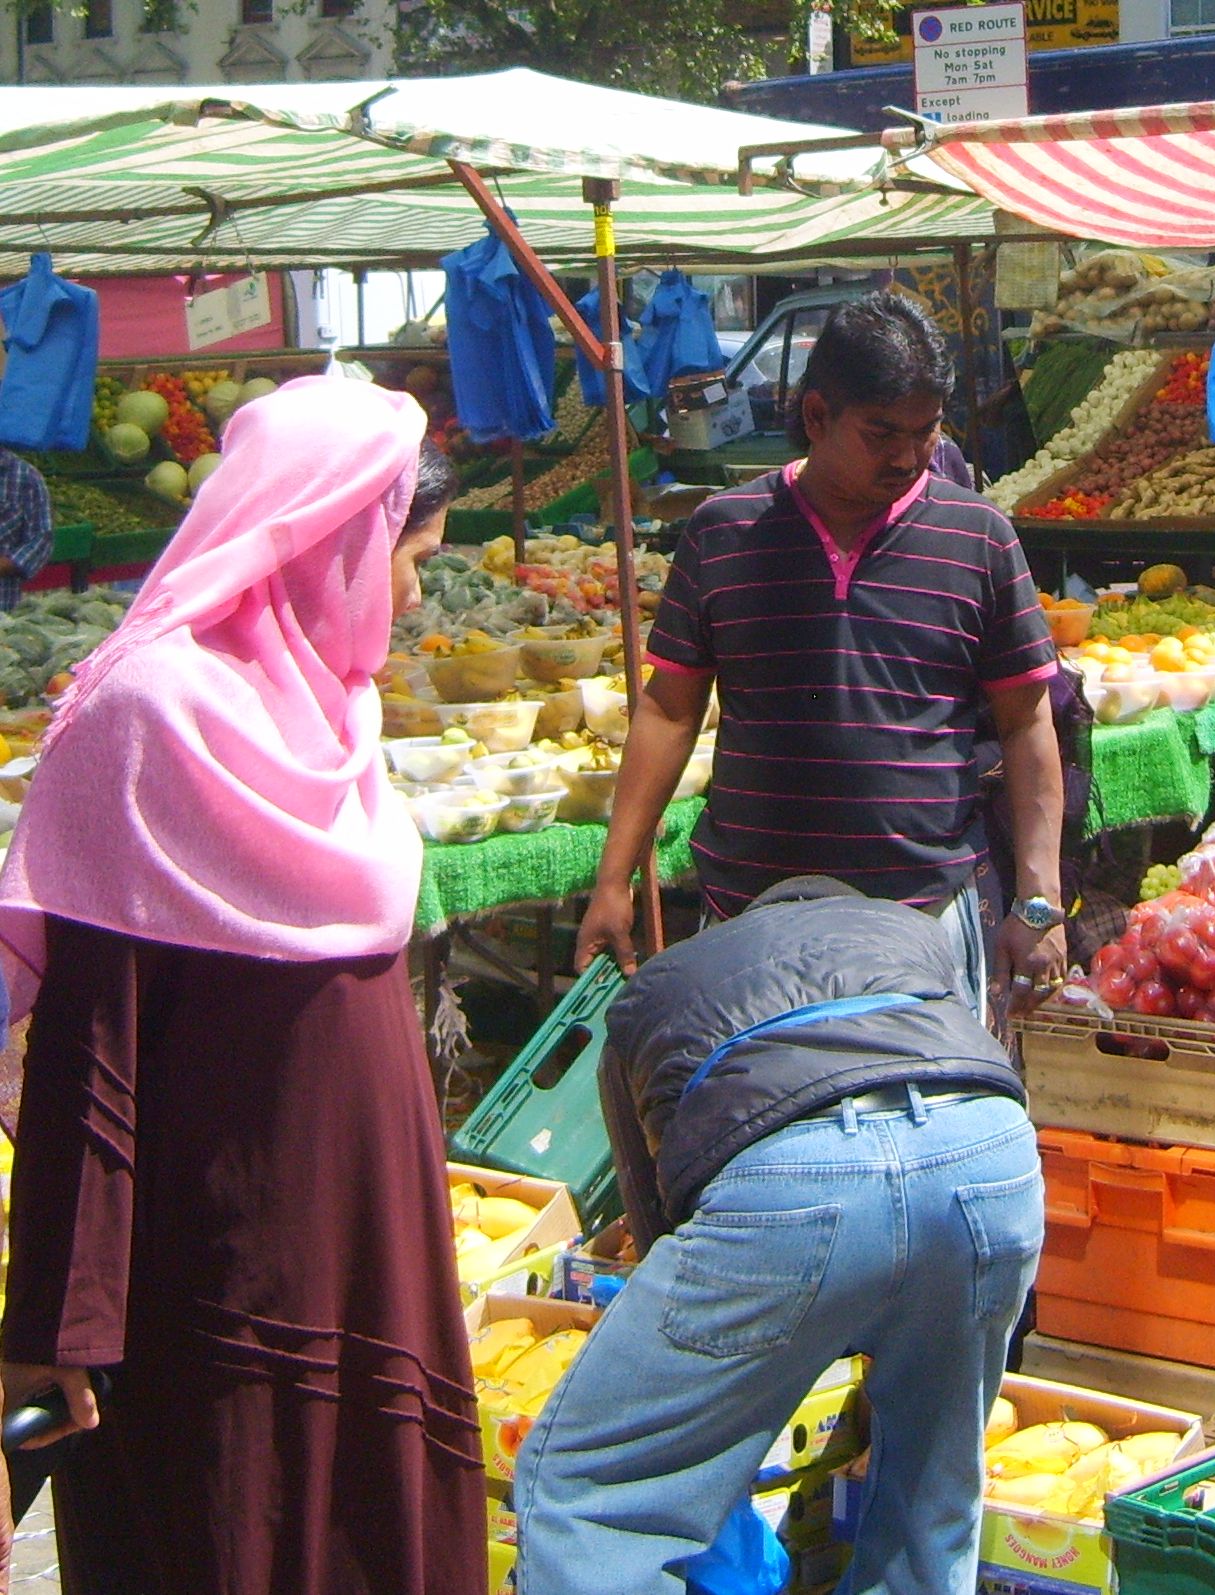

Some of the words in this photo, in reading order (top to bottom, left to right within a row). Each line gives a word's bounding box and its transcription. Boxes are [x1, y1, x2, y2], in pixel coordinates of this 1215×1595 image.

[950, 22, 973, 33] RED
[978, 18, 1017, 31] ROUTE
[934, 48, 950, 59] No
[955, 45, 1006, 58] stopping
[944, 62, 968, 73] Mon
[974, 60, 993, 70] Sat
[945, 75, 968, 85] 7am
[973, 73, 996, 84] 7pm
[921, 95, 961, 108] Except
[946, 111, 990, 122] loading
[1005, 1534, 1048, 1569] MANGOES
